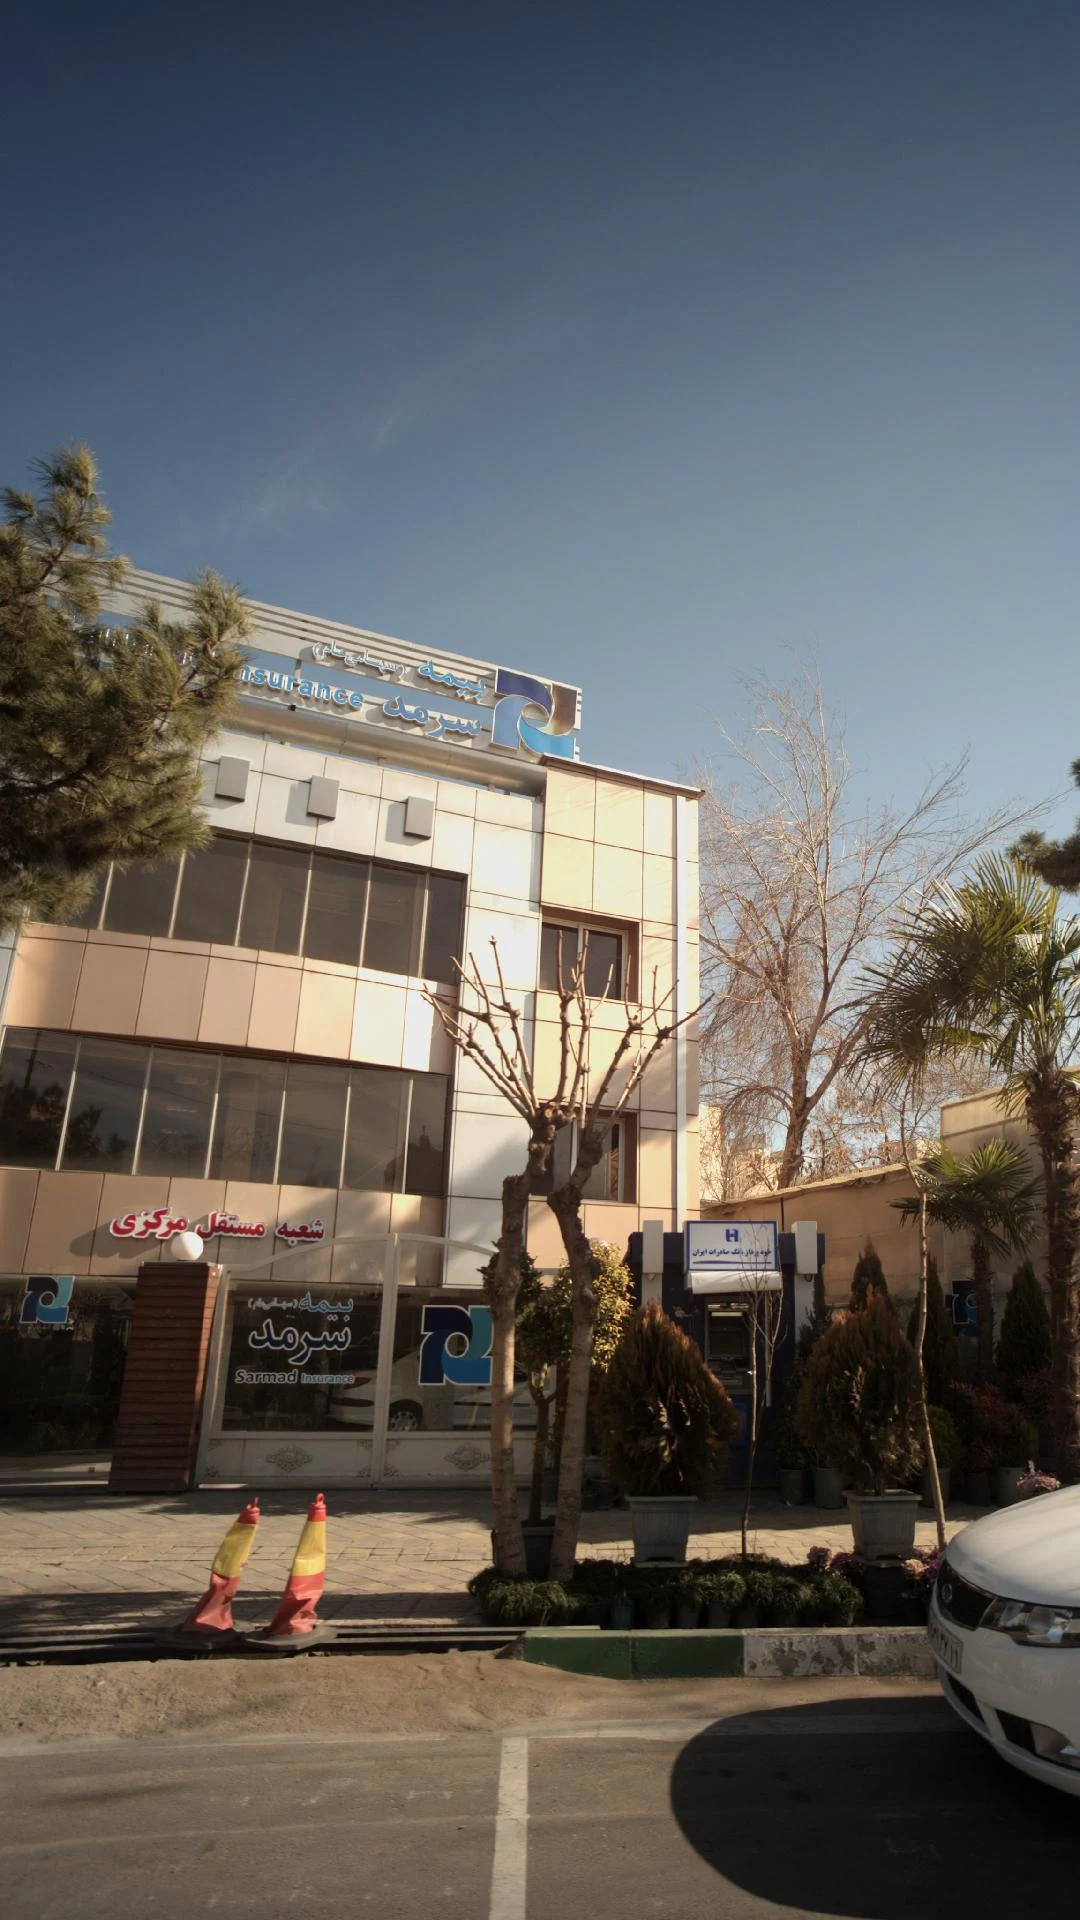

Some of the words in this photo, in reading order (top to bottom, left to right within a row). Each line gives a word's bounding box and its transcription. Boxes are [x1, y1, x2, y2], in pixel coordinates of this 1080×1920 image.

[242, 665, 364, 708] surance
[417, 659, 486, 699] بیمه
[382, 695, 481, 738] سرمد
[110, 1208, 188, 1240] مرکزی
[196, 1211, 266, 1240] مستقل
[274, 1218, 325, 1246] شعبه
[692, 1247, 708, 1257] ایران
[299, 1290, 354, 1321] بیمه
[248, 1318, 352, 1365] سرمد
[235, 1368, 299, 1384] Sarmad
[300, 1373, 356, 1384] Insurance
